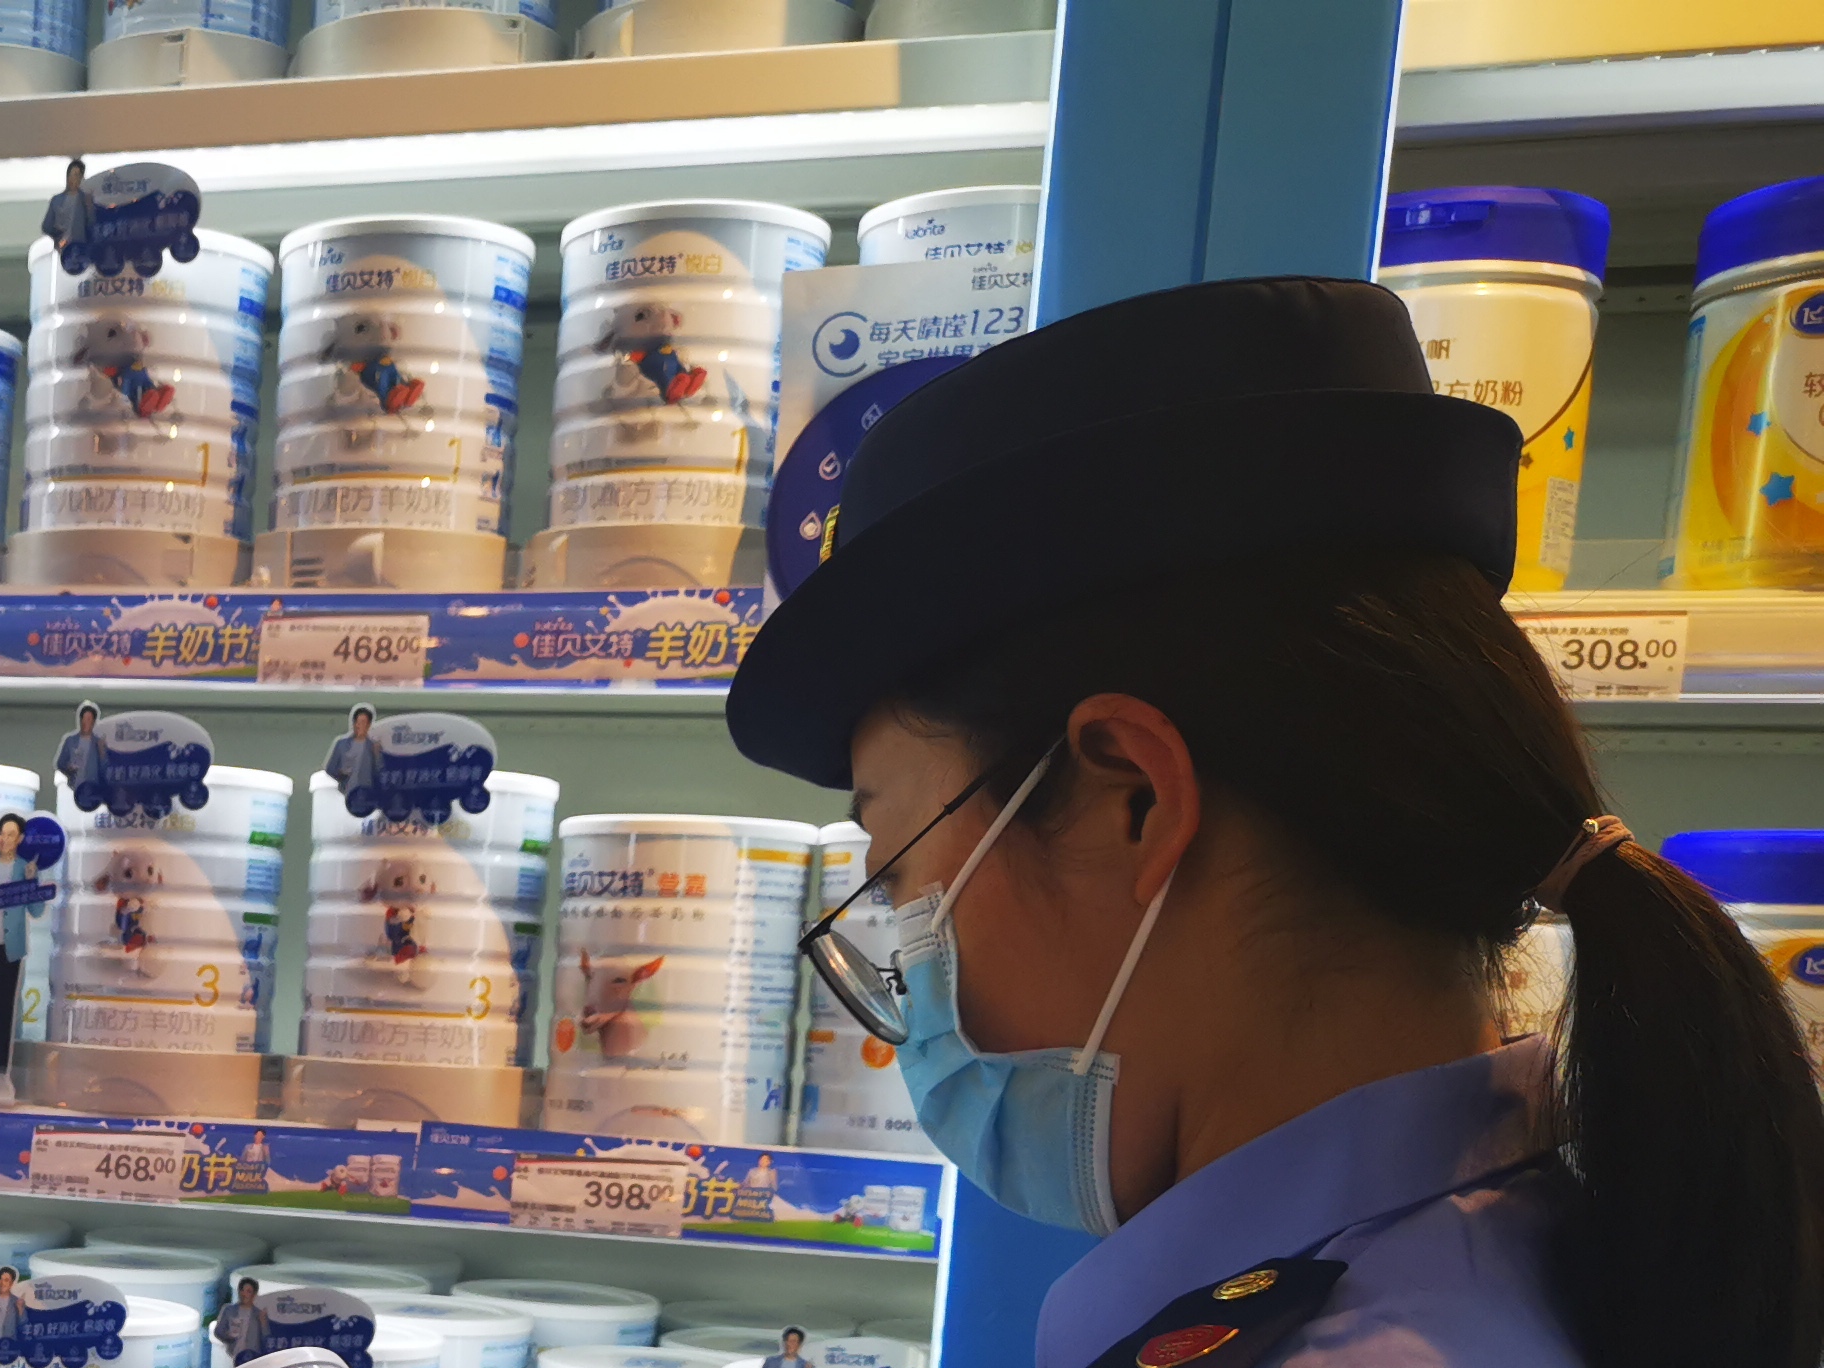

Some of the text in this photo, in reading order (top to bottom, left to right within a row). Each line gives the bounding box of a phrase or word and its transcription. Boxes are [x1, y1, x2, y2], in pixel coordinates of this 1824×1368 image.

[605, 255, 677, 281] 佳贝艾特
[143, 625, 253, 666] 羊奶节
[333, 634, 421, 666] 468.00
[532, 634, 634, 659] 佳贝艾特
[1561, 638, 1678, 671] 308.00
[194, 963, 220, 1008] 3
[466, 976, 493, 1021] 3
[22, 988, 40, 1023] 2
[95, 1153, 175, 1182] 468.00
[583, 1180, 674, 1211] 398.00
